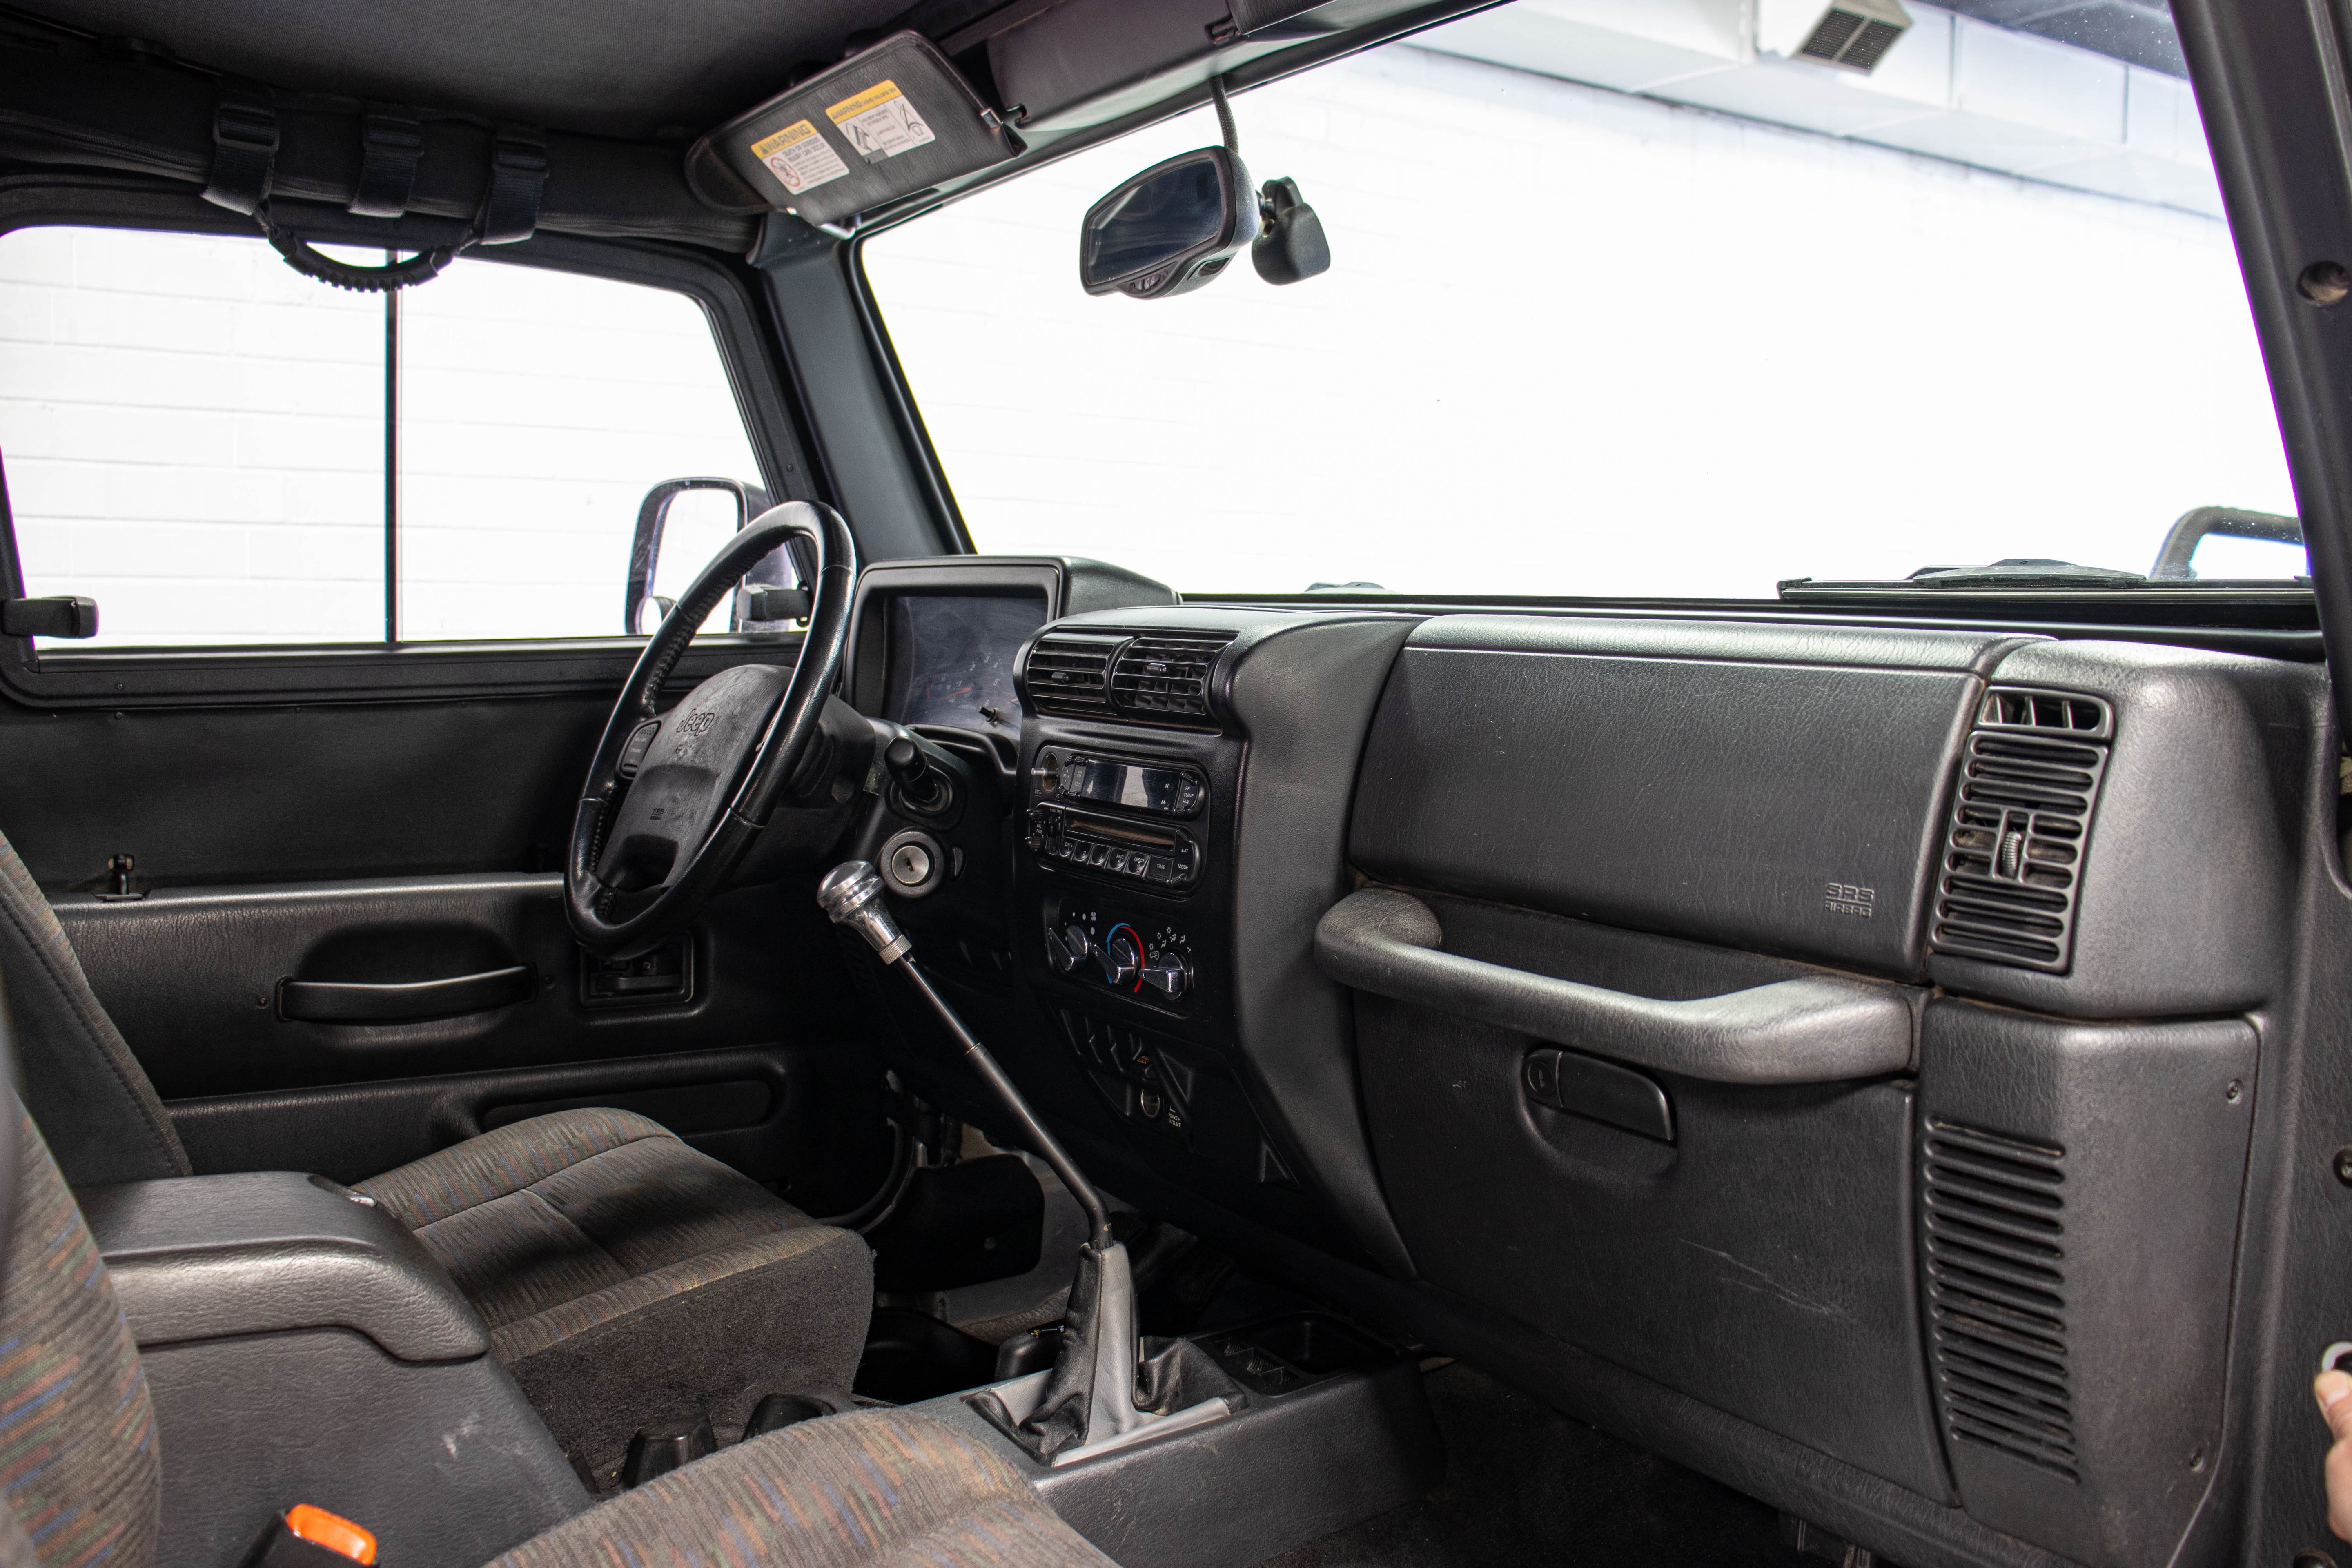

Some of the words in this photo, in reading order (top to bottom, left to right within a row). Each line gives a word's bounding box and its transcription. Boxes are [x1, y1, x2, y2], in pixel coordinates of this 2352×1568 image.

[766, 124, 811, 151] WARNING
[676, 708, 715, 737] Jeep
[1826, 882, 1874, 901] SRS
[1824, 901, 1872, 917] AIRBAG
[1168, 1112, 1181, 1122] POWER
[1168, 1118, 1182, 1128] OUTLET
